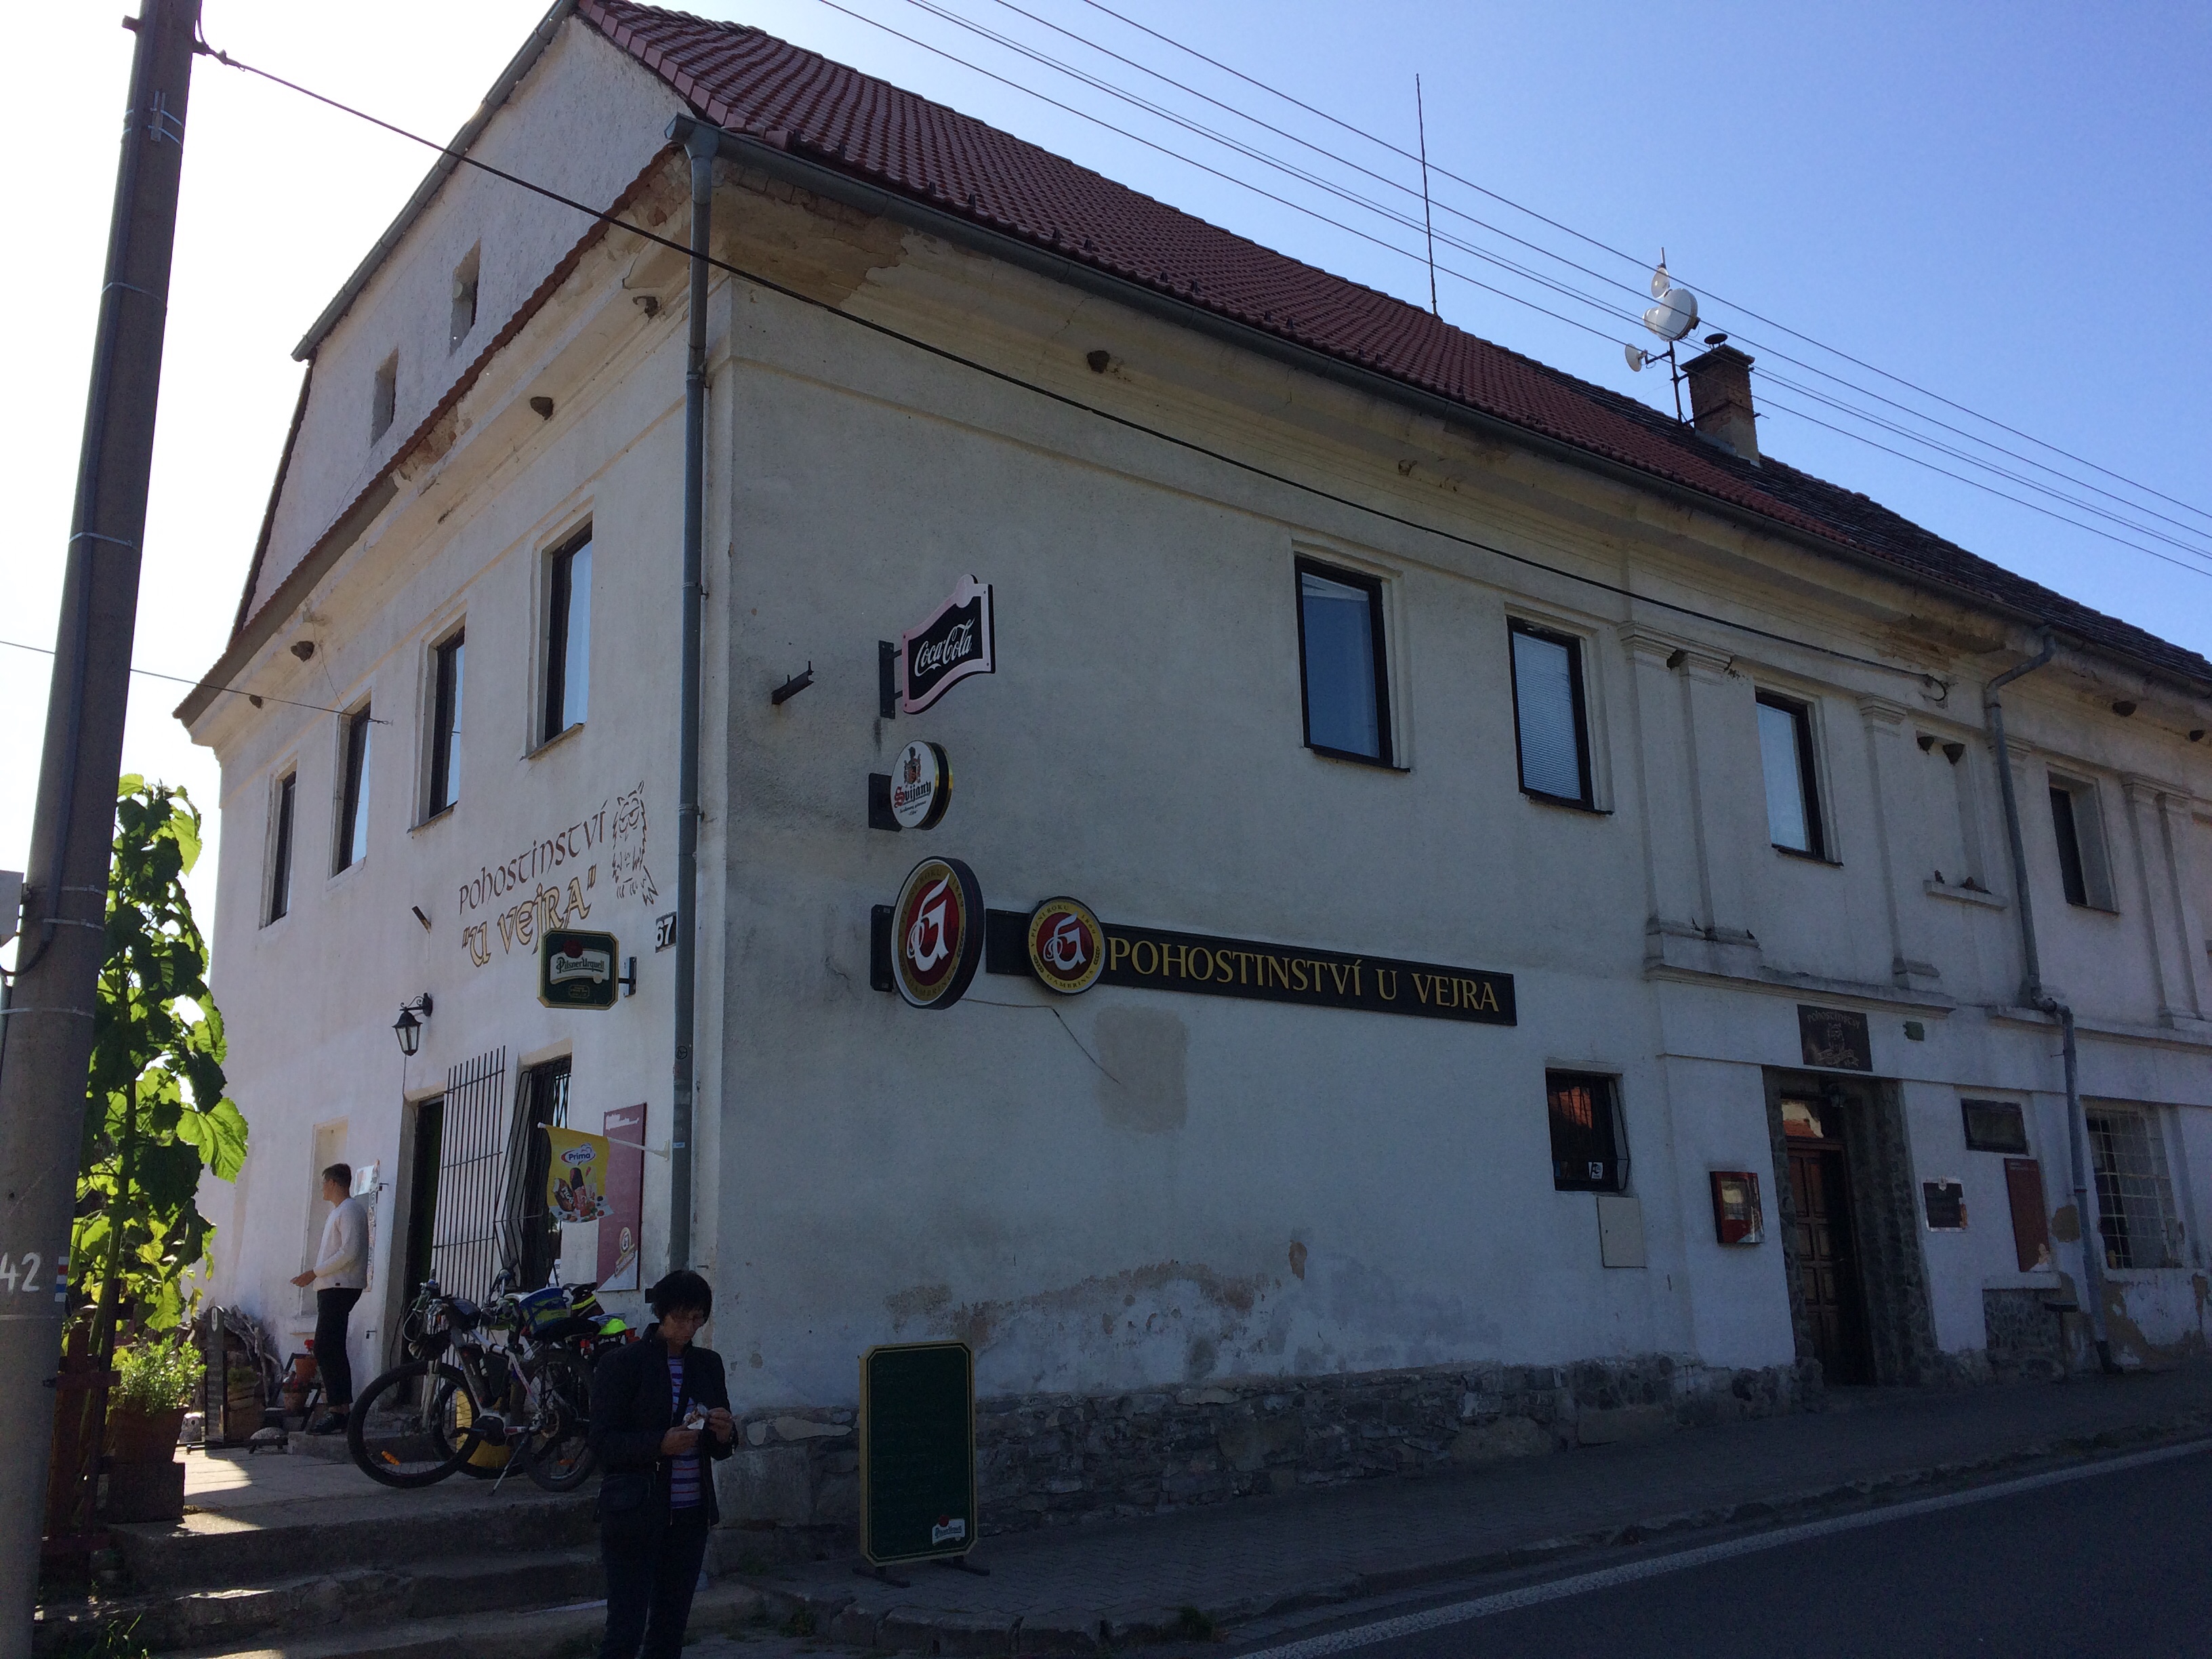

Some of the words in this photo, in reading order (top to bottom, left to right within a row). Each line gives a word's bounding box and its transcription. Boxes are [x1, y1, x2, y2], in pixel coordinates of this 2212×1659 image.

[894, 781, 932, 808] Svijany
[1046, 905, 1069, 914] ROKU
[656, 916, 674, 947] 67
[556, 956, 583, 975] Pilsner
[1107, 936, 1362, 996] POHOSTINSTVÍ
[1376, 968, 1397, 1001] U
[1412, 972, 1500, 1012] VEJRA
[1046, 970, 1094, 989] GAMBRINUS
[569, 1152, 591, 1161] Prima
